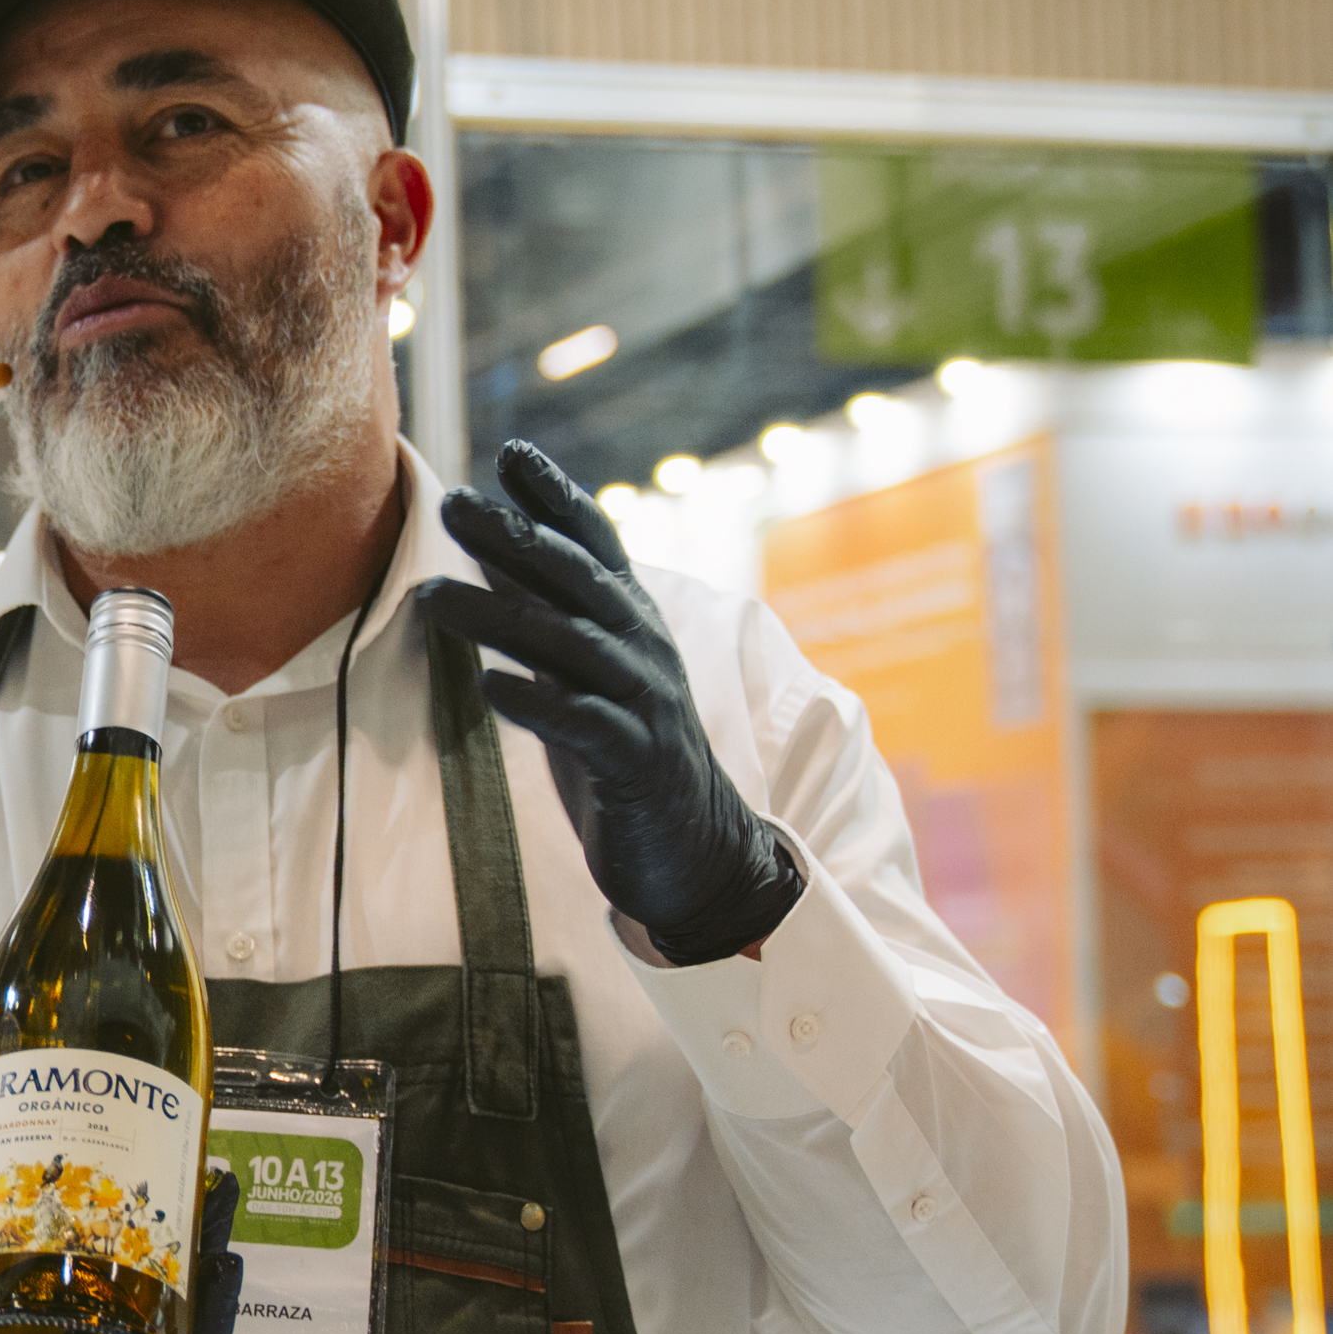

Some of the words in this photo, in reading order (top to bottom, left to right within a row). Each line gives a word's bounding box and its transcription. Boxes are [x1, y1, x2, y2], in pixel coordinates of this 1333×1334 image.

[18, 1097, 104, 1115] ORGÁNICO
[14, 1134, 53, 1142] RESERVA
[248, 1155, 283, 1186] 10
[285, 1158, 309, 1188] A
[313, 1160, 345, 1191] 13
[247, 1184, 343, 1206] JUNHO/2026
